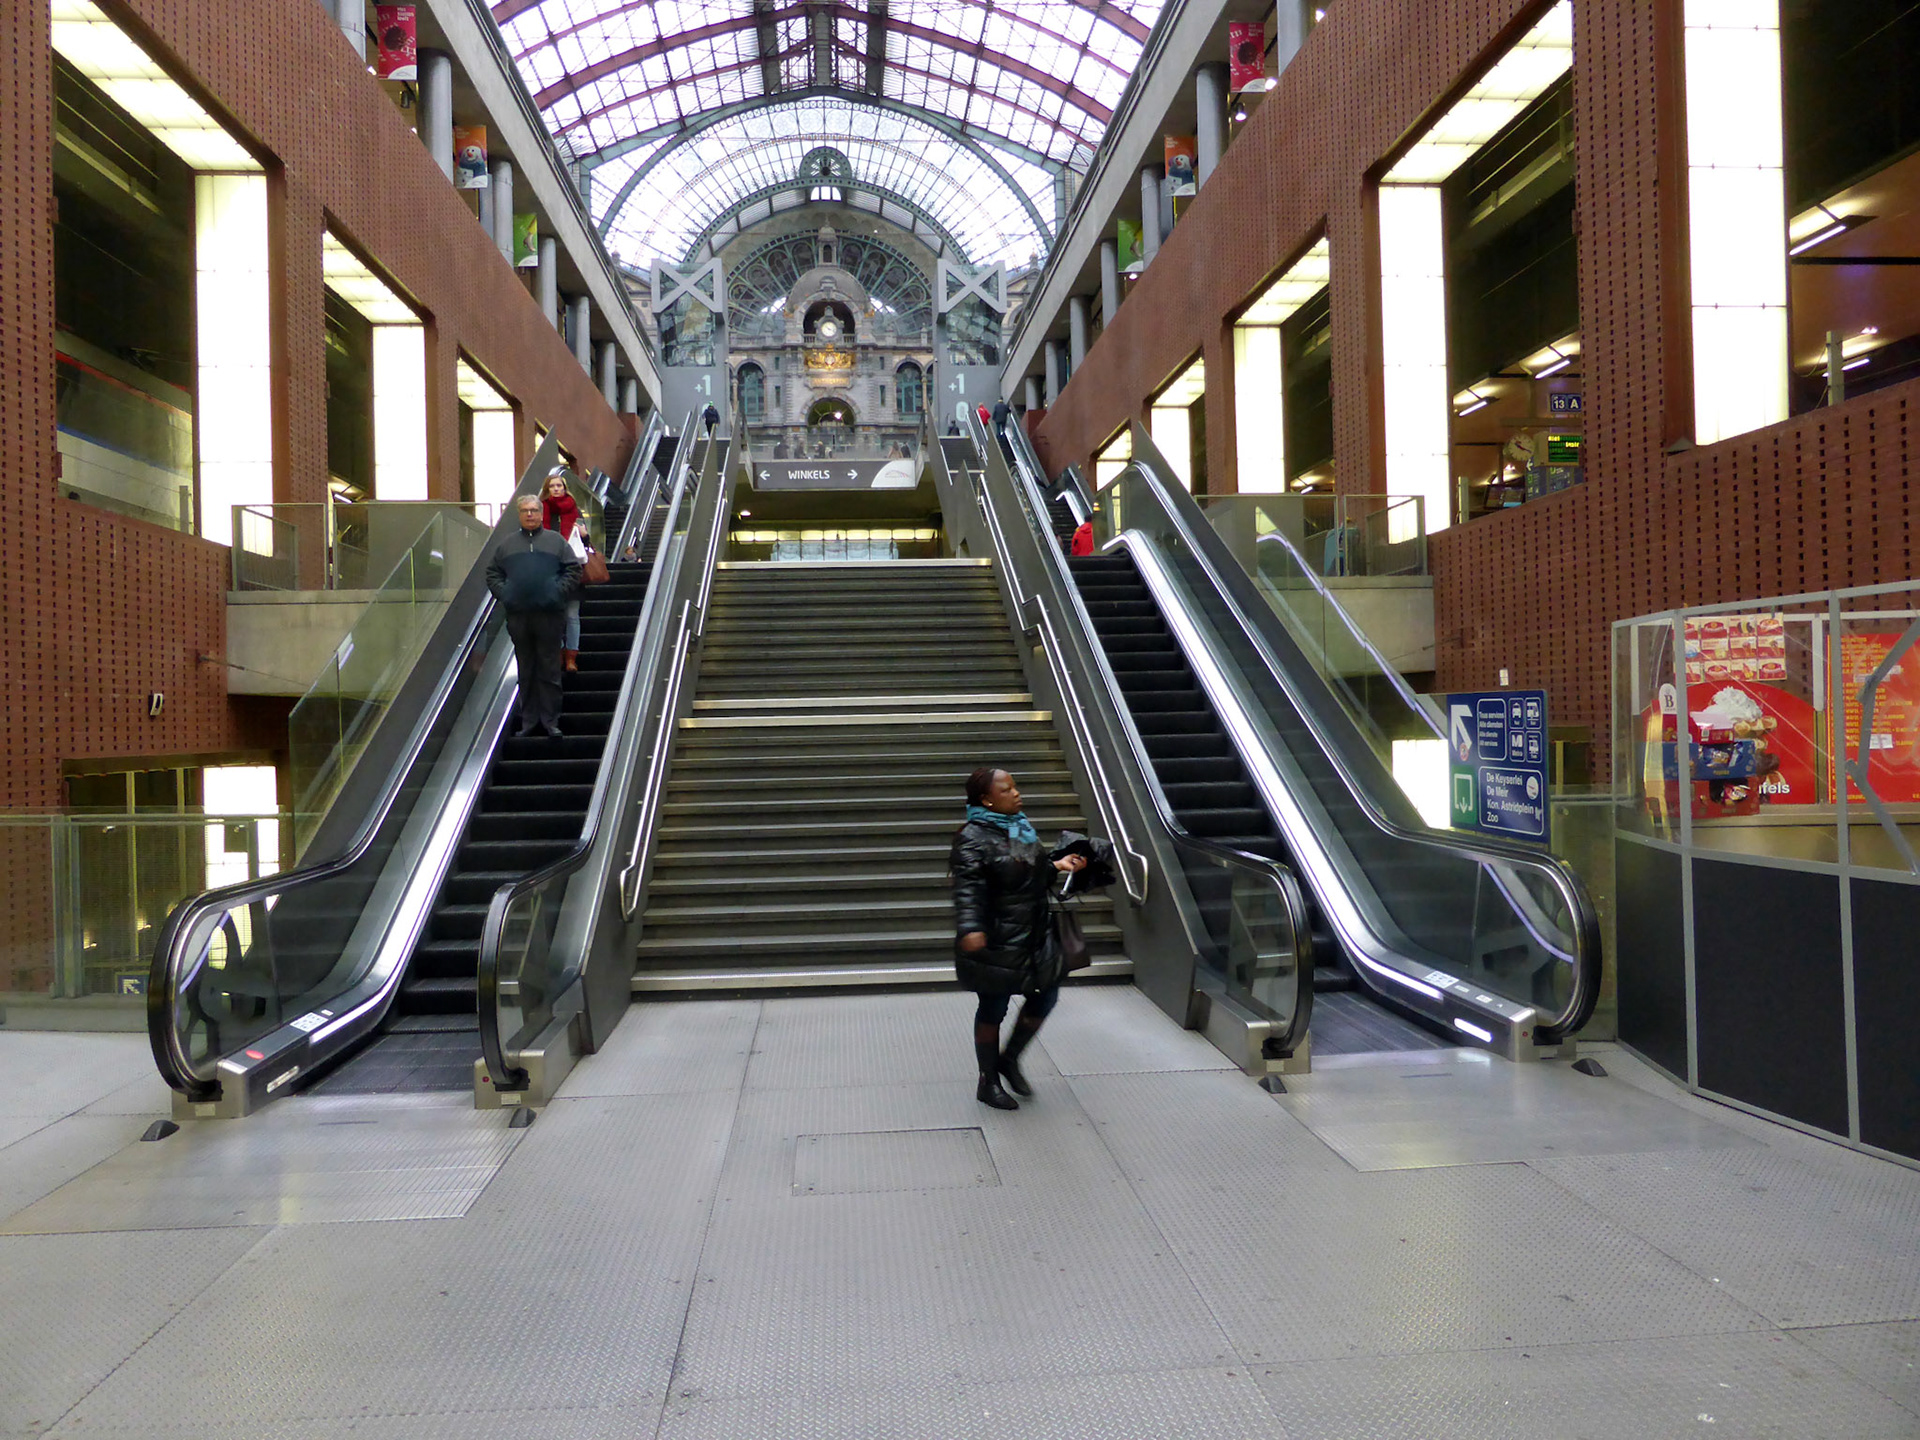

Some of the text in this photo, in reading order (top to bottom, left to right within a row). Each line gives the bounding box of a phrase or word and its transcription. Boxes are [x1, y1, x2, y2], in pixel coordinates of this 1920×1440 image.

[694, 374, 711, 396] +1
[948, 373, 965, 395] +1
[1554, 398, 1579, 409] 13 A
[788, 470, 830, 480] WINKELS
[1511, 734, 1523, 748] M
[1486, 772, 1523, 786] De Keyserlei
[1486, 785, 1509, 798] De Meir
[1487, 798, 1534, 815] Kon. Astridplein
[1487, 811, 1499, 823] Zoo
